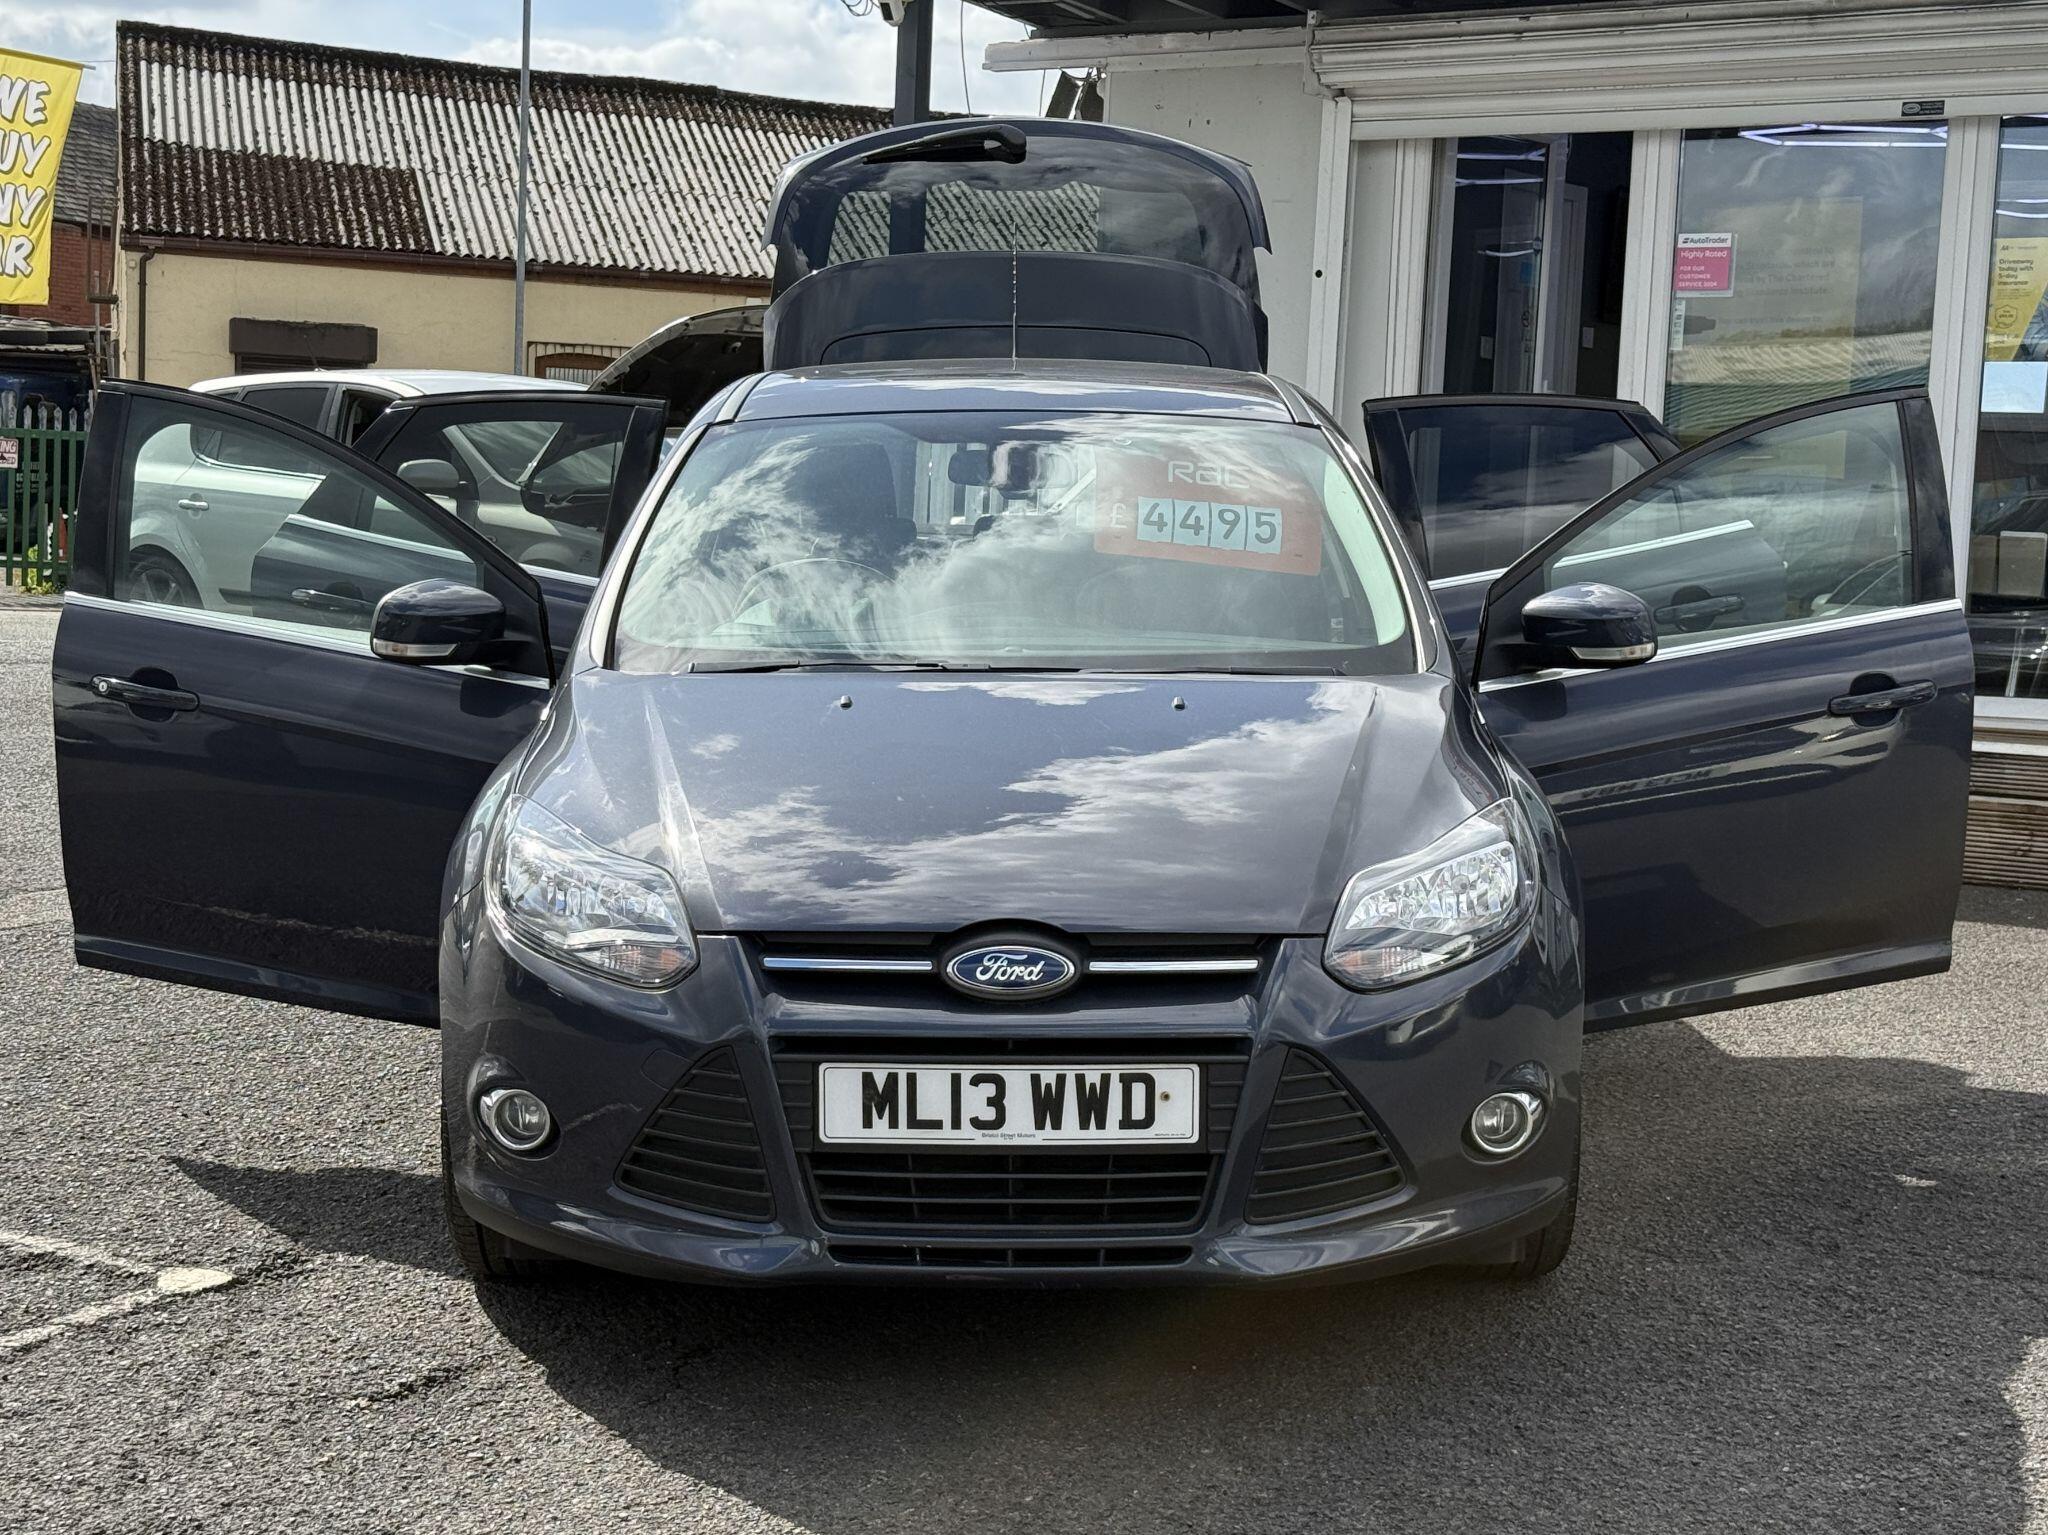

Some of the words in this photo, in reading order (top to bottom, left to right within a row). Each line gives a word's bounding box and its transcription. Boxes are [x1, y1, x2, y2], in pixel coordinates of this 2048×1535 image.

[0, 129, 51, 178] UY
[0, 182, 48, 228] NY
[1680, 250, 1704, 259] Highly
[975, 953, 1046, 981] Ford
[861, 1071, 1007, 1131] ML13
[1029, 1072, 1156, 1131] WWD
